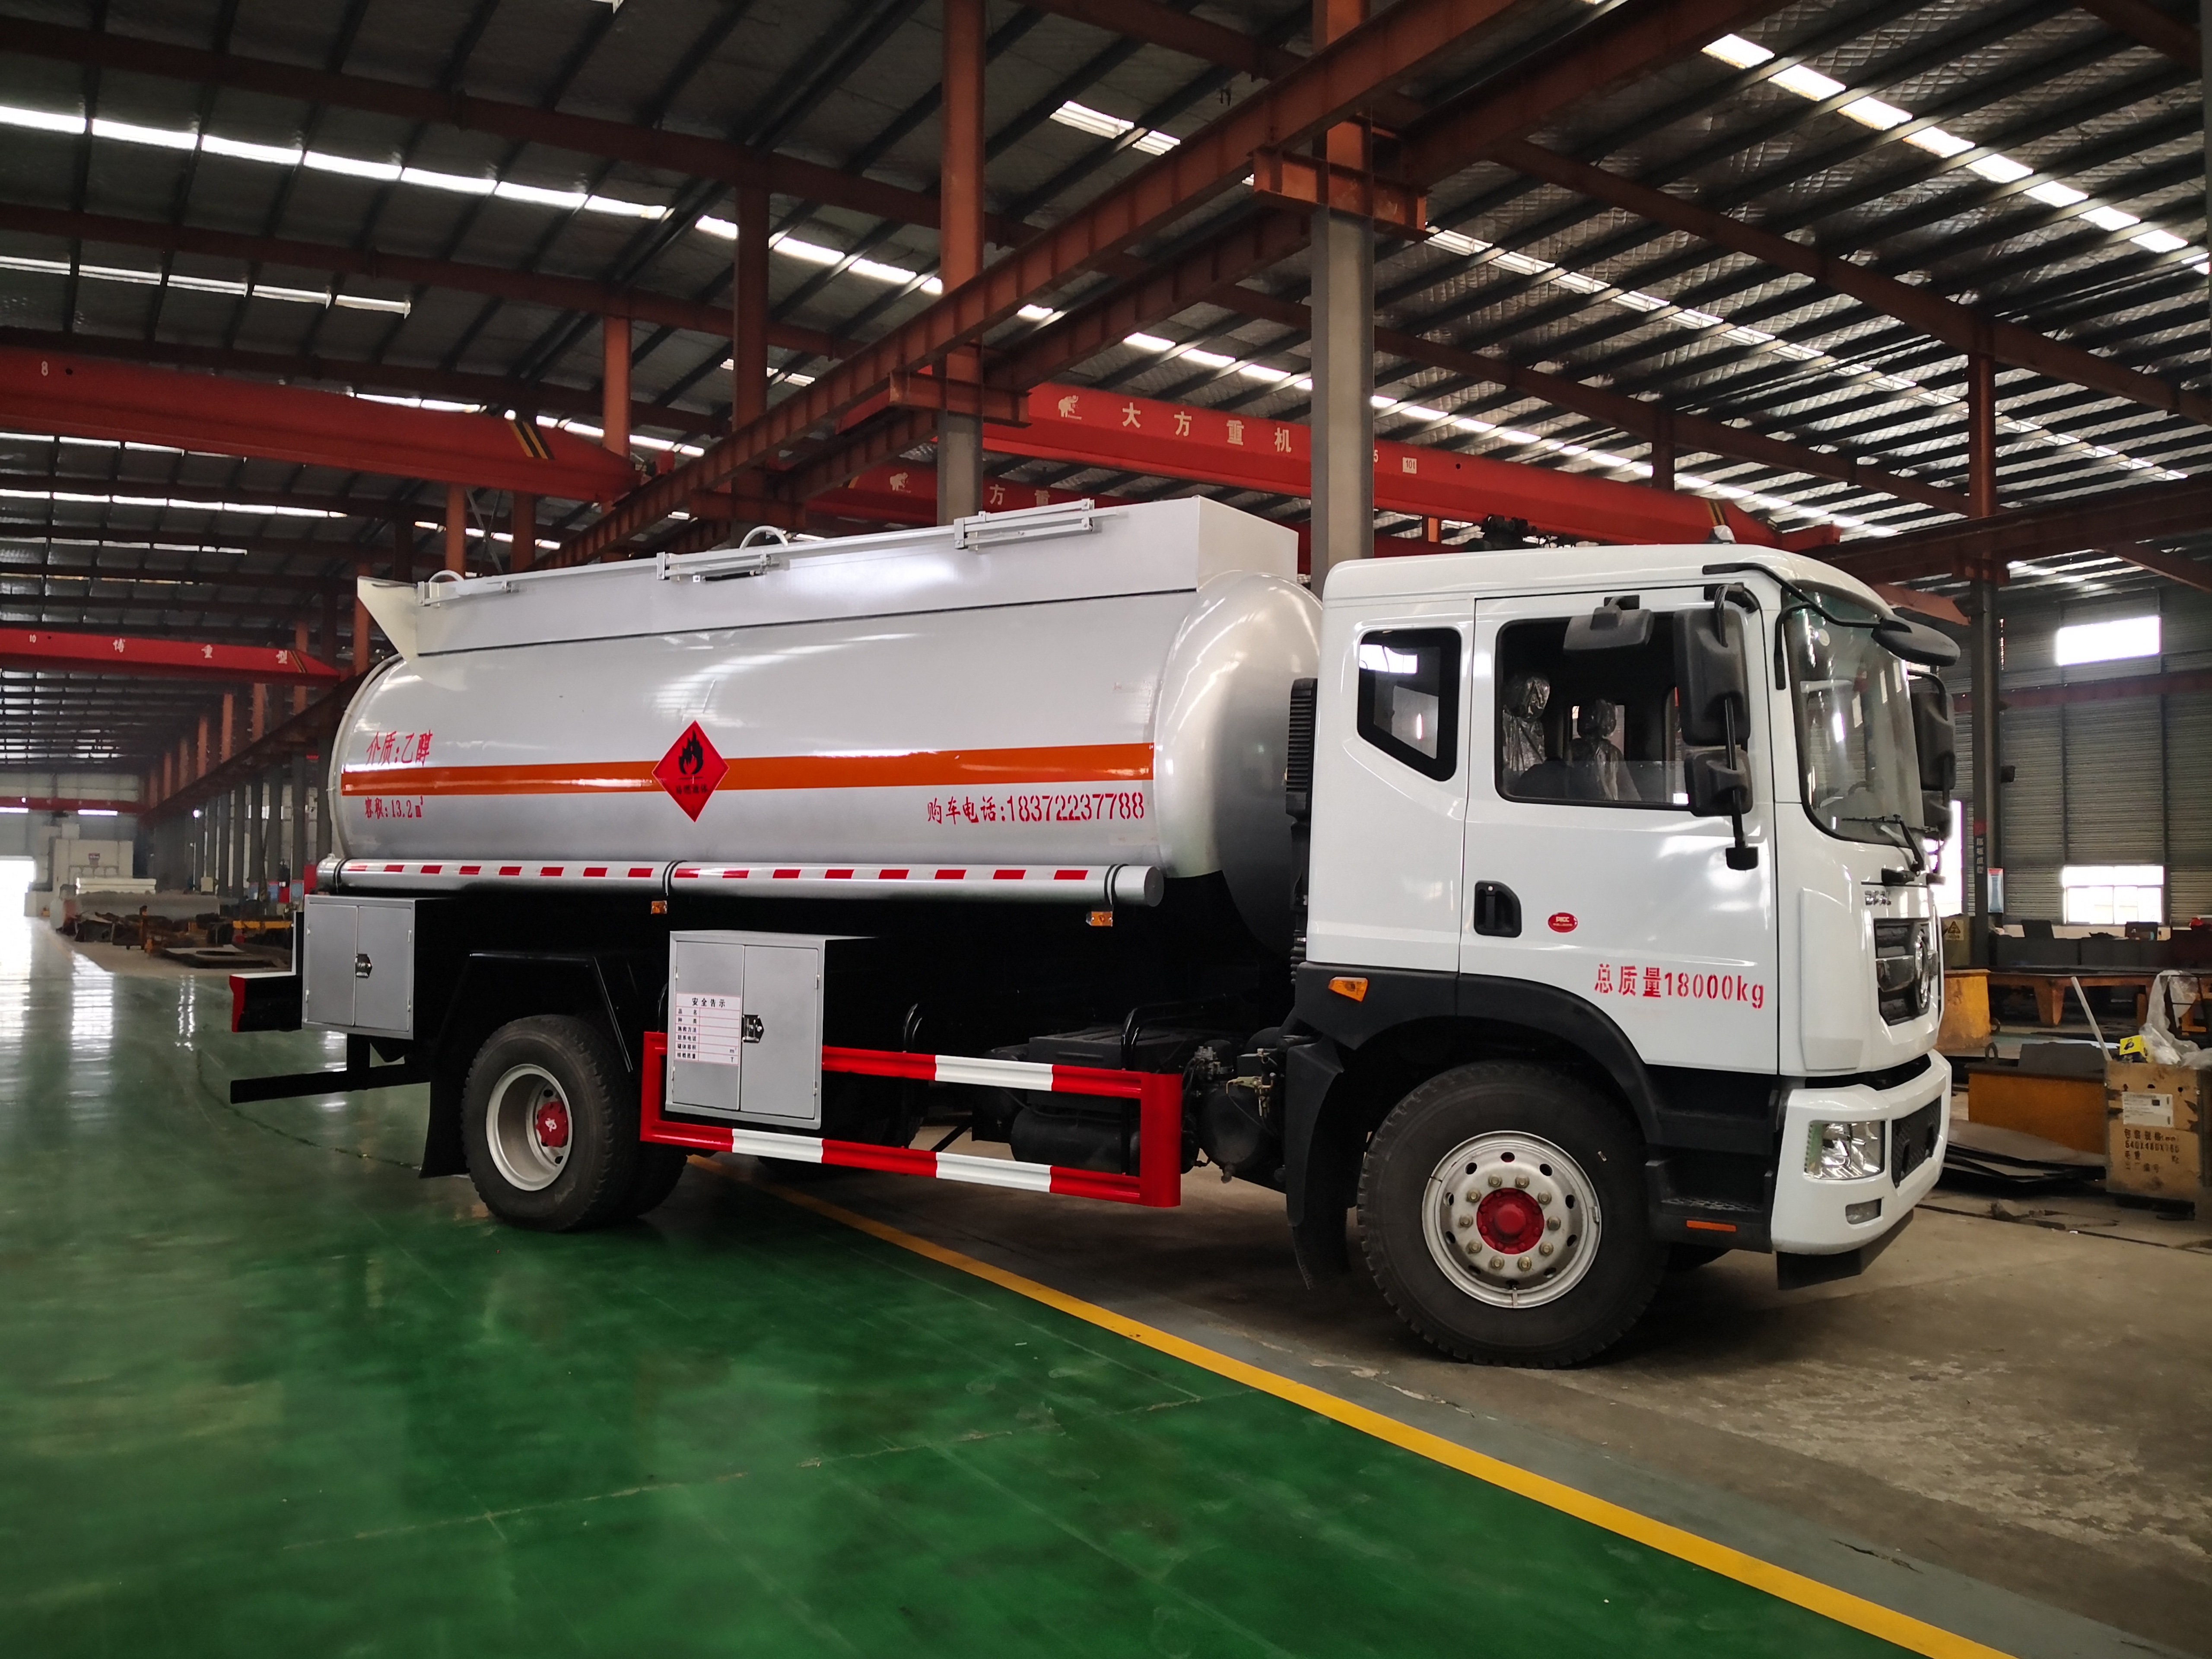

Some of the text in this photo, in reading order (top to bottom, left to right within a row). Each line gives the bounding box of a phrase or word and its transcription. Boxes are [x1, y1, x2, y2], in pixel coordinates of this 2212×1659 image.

[41, 360, 49, 376] 8
[1122, 402, 1292, 453] 大方重机
[29, 634, 37, 643] 10
[366, 729, 433, 767] 介质:乙醇
[927, 792, 1145, 825] 购车电话:18372237788
[1594, 963, 1765, 1009] 总质量18000kg
[692, 998, 726, 1008] 安全告示
